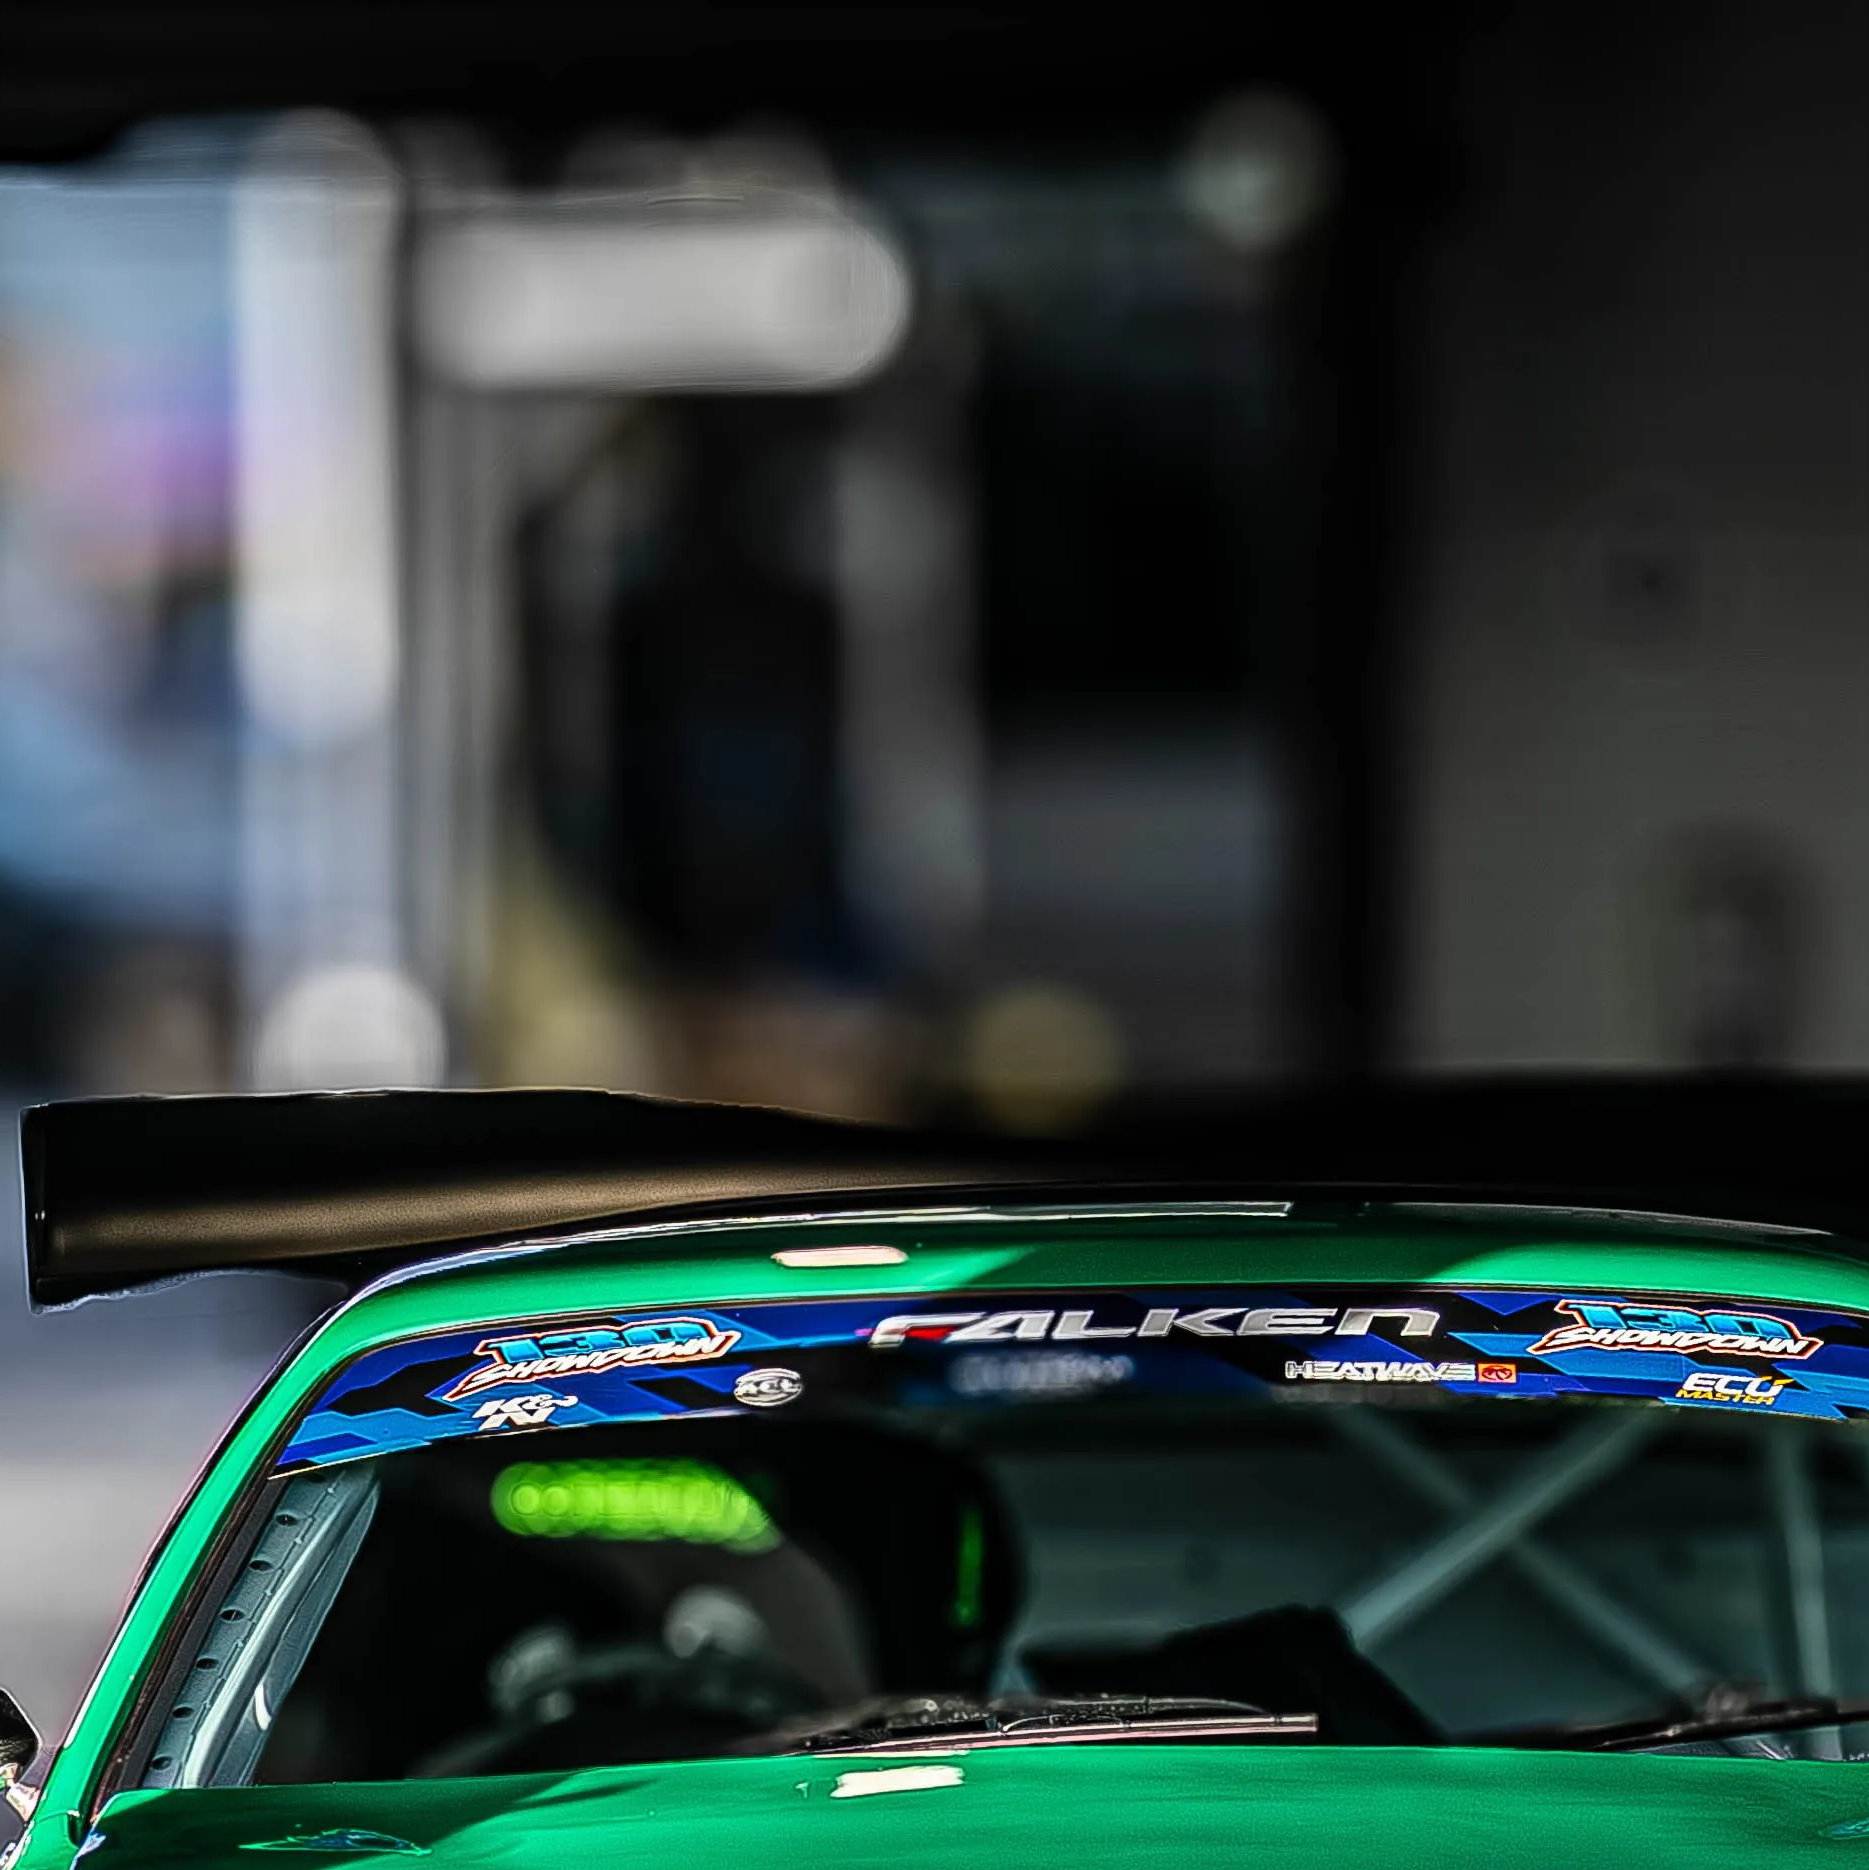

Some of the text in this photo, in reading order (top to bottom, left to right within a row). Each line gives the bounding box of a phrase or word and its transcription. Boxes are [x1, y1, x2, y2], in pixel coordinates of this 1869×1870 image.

[870, 1307, 1440, 1348] FALKEN
[1566, 1303, 1790, 1339] 130
[485, 1321, 718, 1363] 130
[1544, 1327, 1810, 1354] SHOWDOWN
[462, 1334, 726, 1390] SHOWDOWN
[1284, 1360, 1476, 1382] HEATWAVE
[1675, 1389, 1776, 1406] MASTER
[1680, 1371, 1786, 1398] ECU
